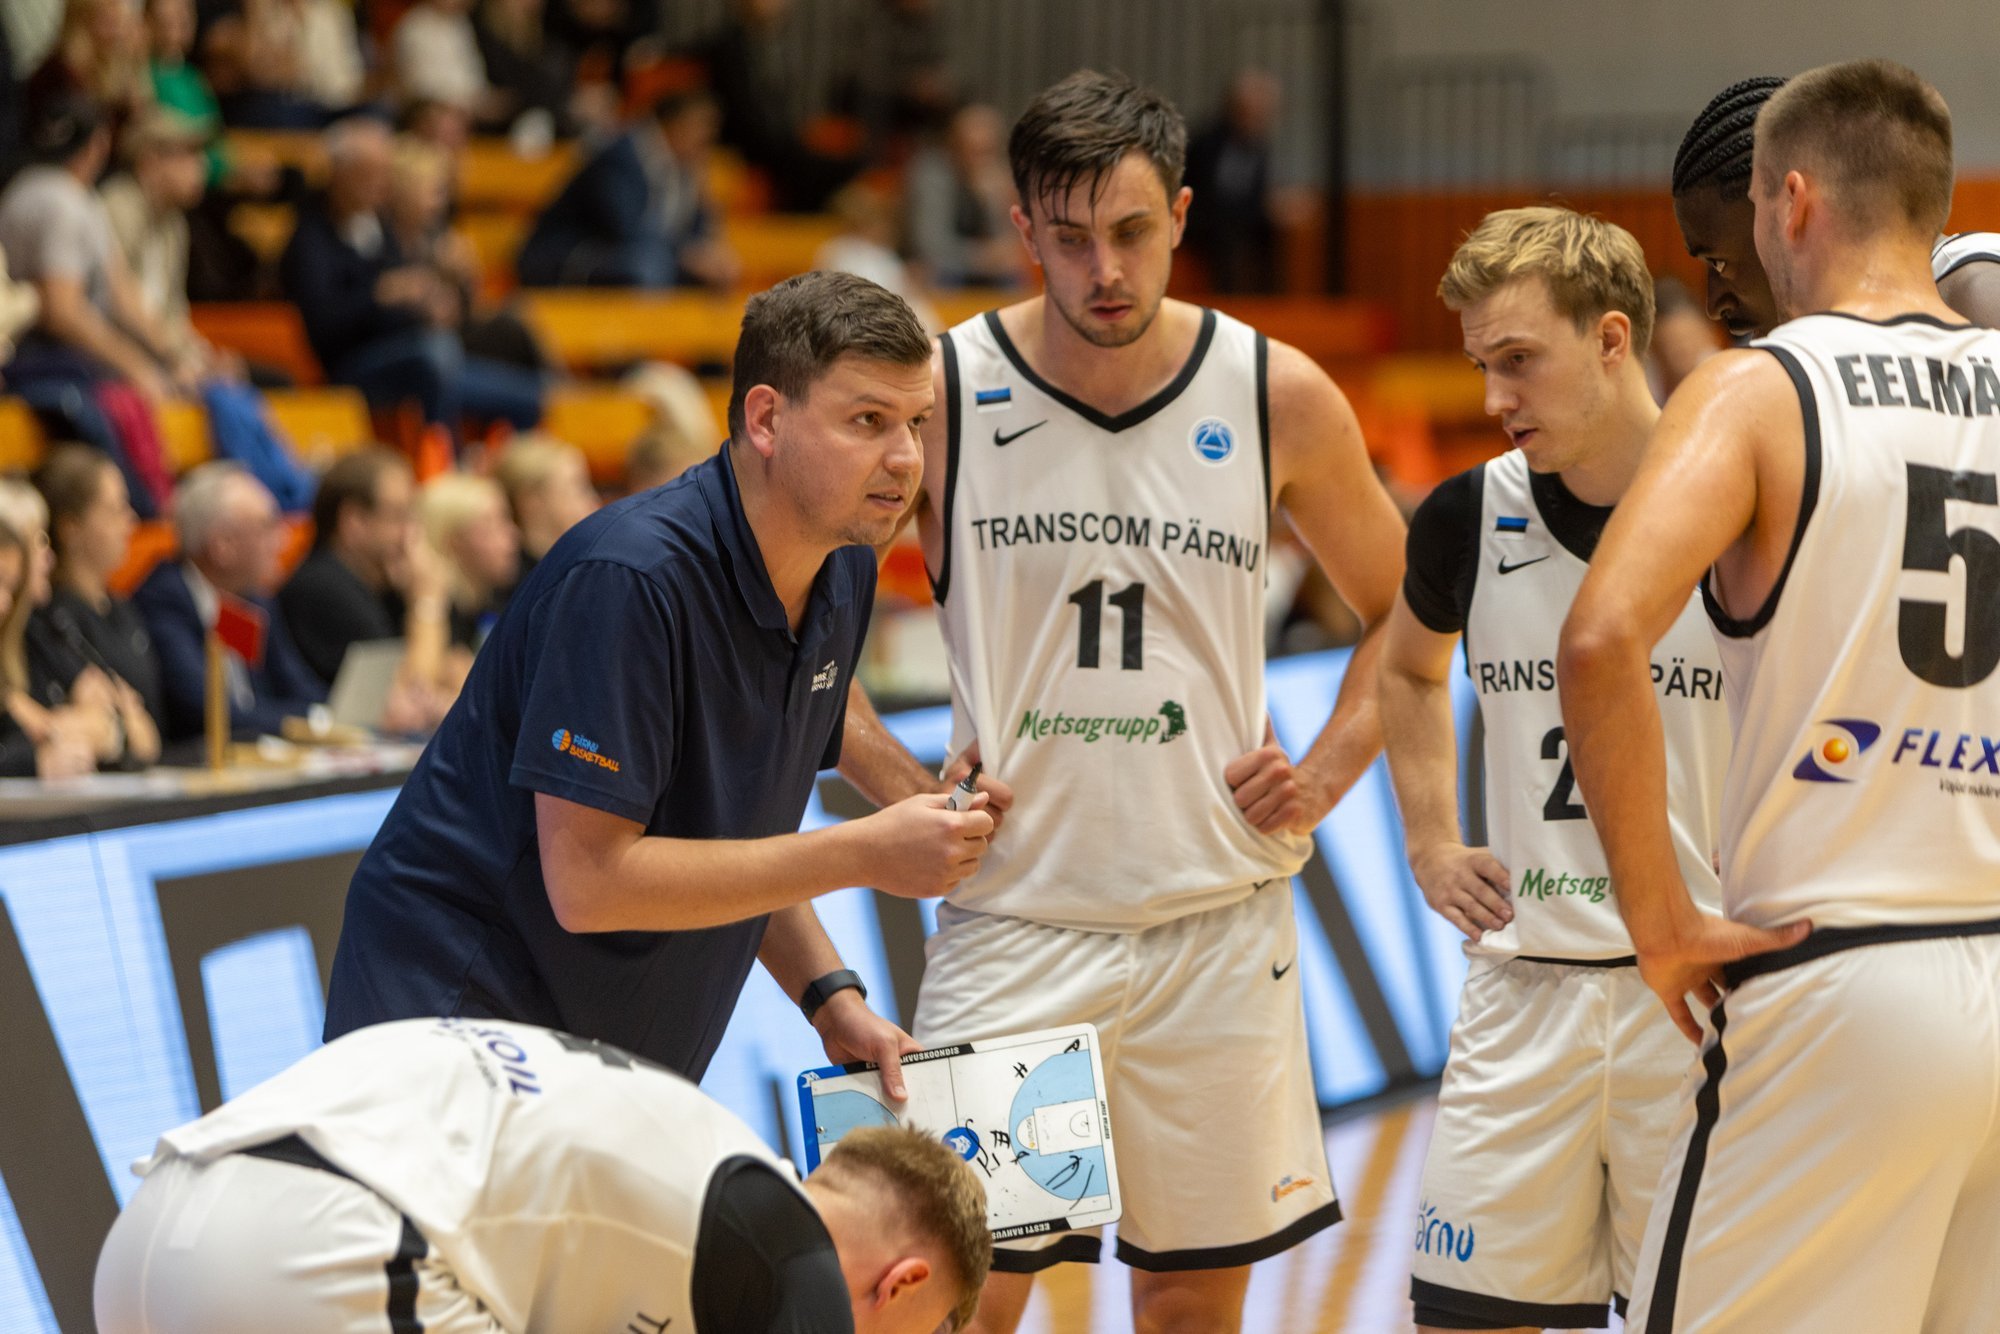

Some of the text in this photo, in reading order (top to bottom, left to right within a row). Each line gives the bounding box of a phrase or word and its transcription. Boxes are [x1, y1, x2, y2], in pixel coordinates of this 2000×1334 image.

[972, 512, 1260, 572] TRANSCOM PÄRNU
[1898, 463, 2000, 688] 5
[1068, 579, 1145, 671] 11
[1016, 709, 1160, 743] Metsagrupp
[1541, 726, 1588, 821] 2
[1025, 1222, 1051, 1235] EESTI
